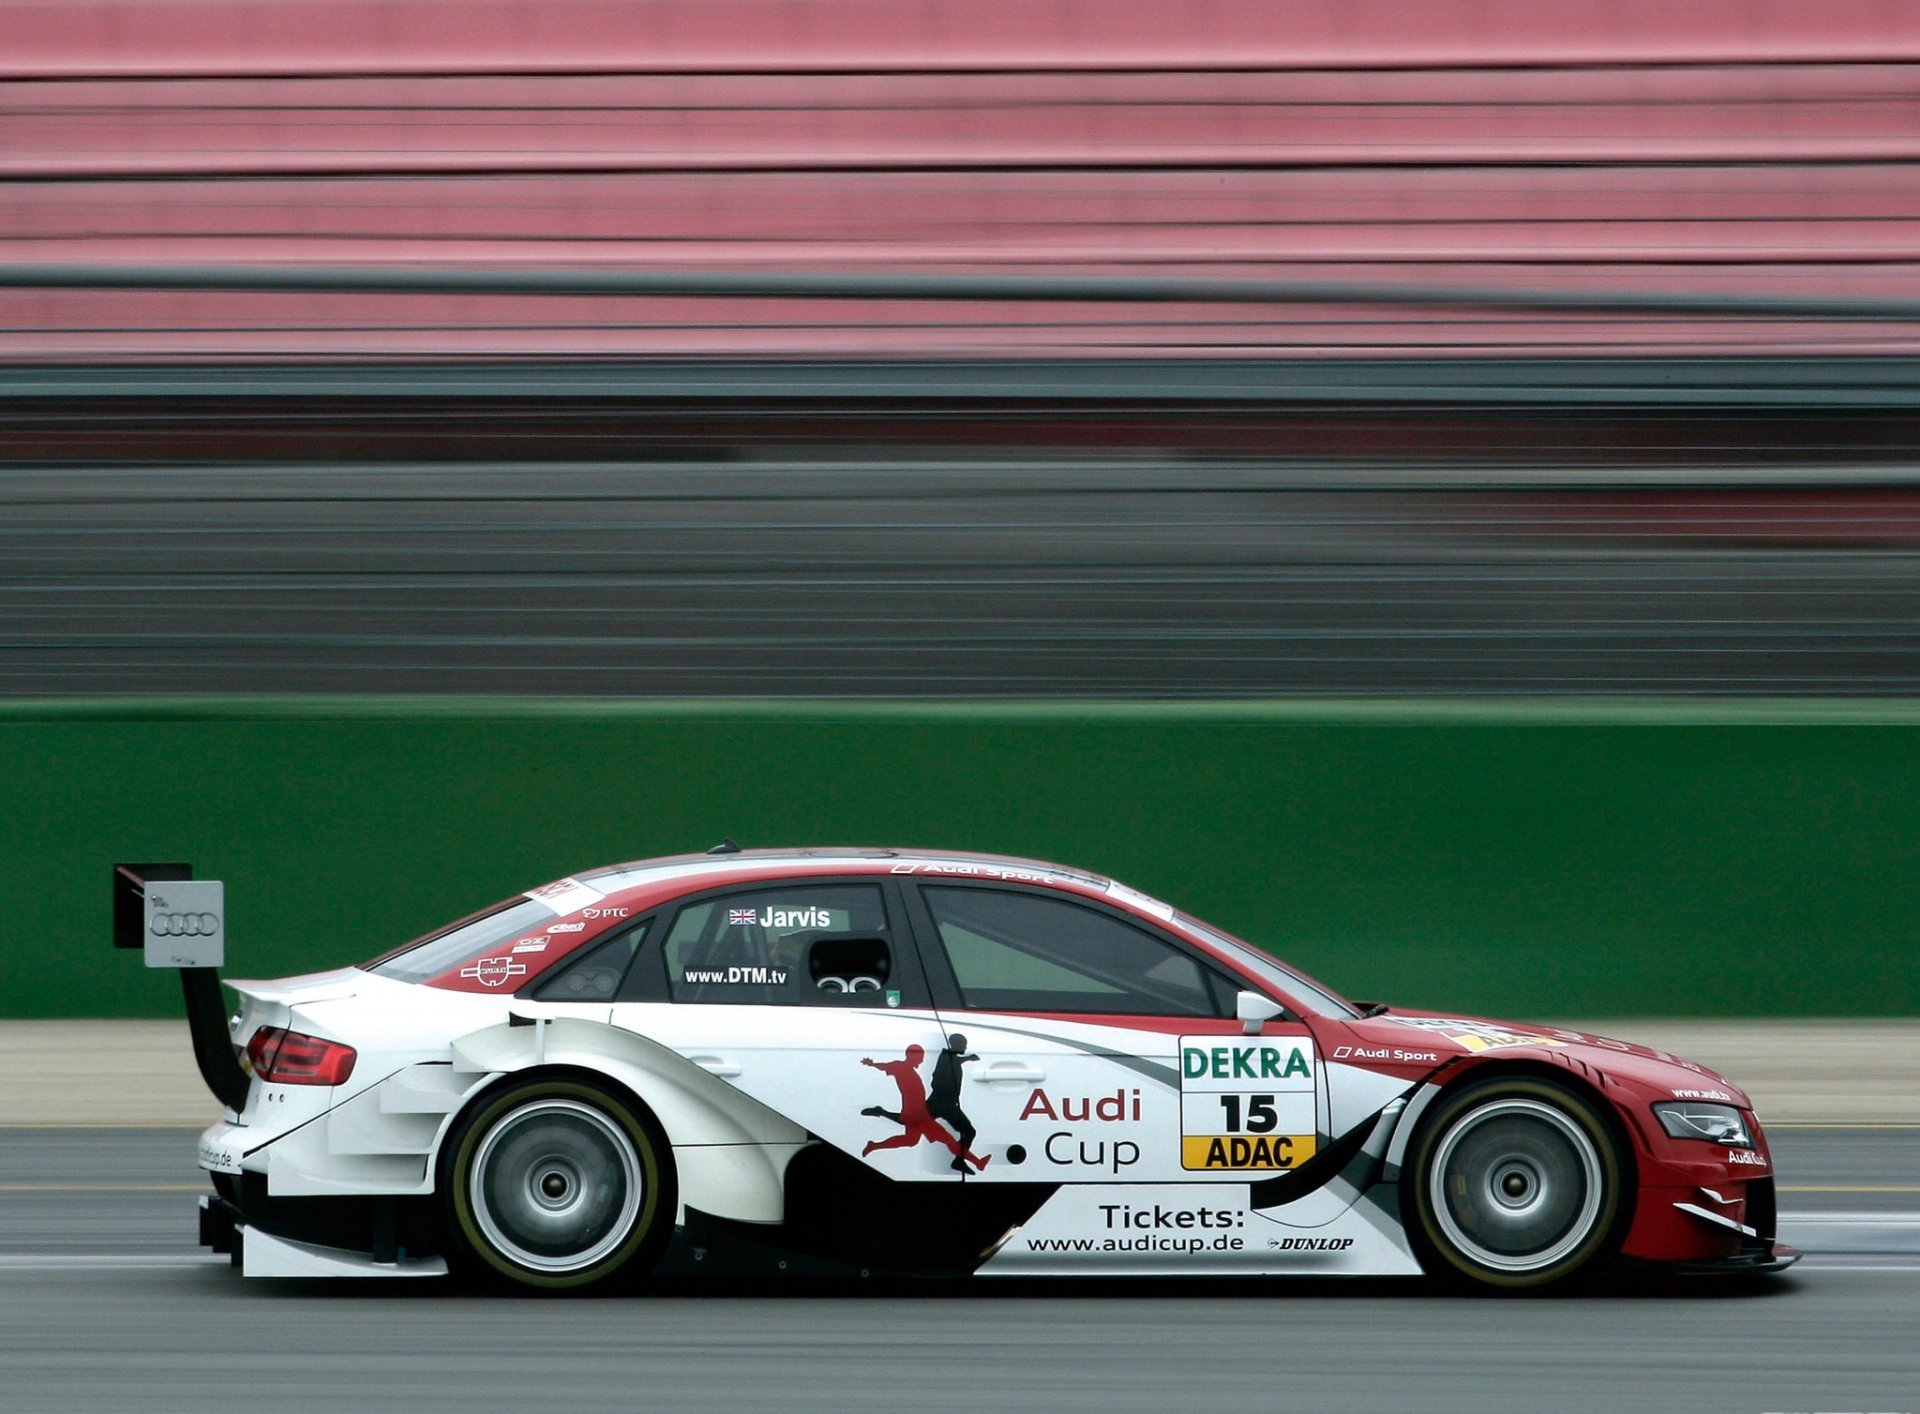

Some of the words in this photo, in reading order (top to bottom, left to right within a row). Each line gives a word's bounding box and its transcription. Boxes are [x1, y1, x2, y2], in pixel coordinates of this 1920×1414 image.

[924, 865, 979, 875] Audi
[986, 869, 1054, 884] Sport
[602, 908, 629, 918] PTC
[760, 906, 831, 928] Jarvis
[685, 967, 787, 984] www.DTM.tv
[1183, 1047, 1311, 1079] DEKRA
[1354, 1048, 1390, 1059] Audi
[1394, 1050, 1437, 1062] Sport
[1019, 1088, 1141, 1122] Audi
[1220, 1094, 1279, 1133] 15
[1045, 1131, 1140, 1174] Cup
[1205, 1137, 1294, 1168] ADAC
[1728, 1150, 1753, 1164] Audi
[1099, 1205, 1245, 1228] Tickets:
[1027, 1235, 1245, 1255] www.audicup.de
[1279, 1238, 1354, 1250] DUNLOP
